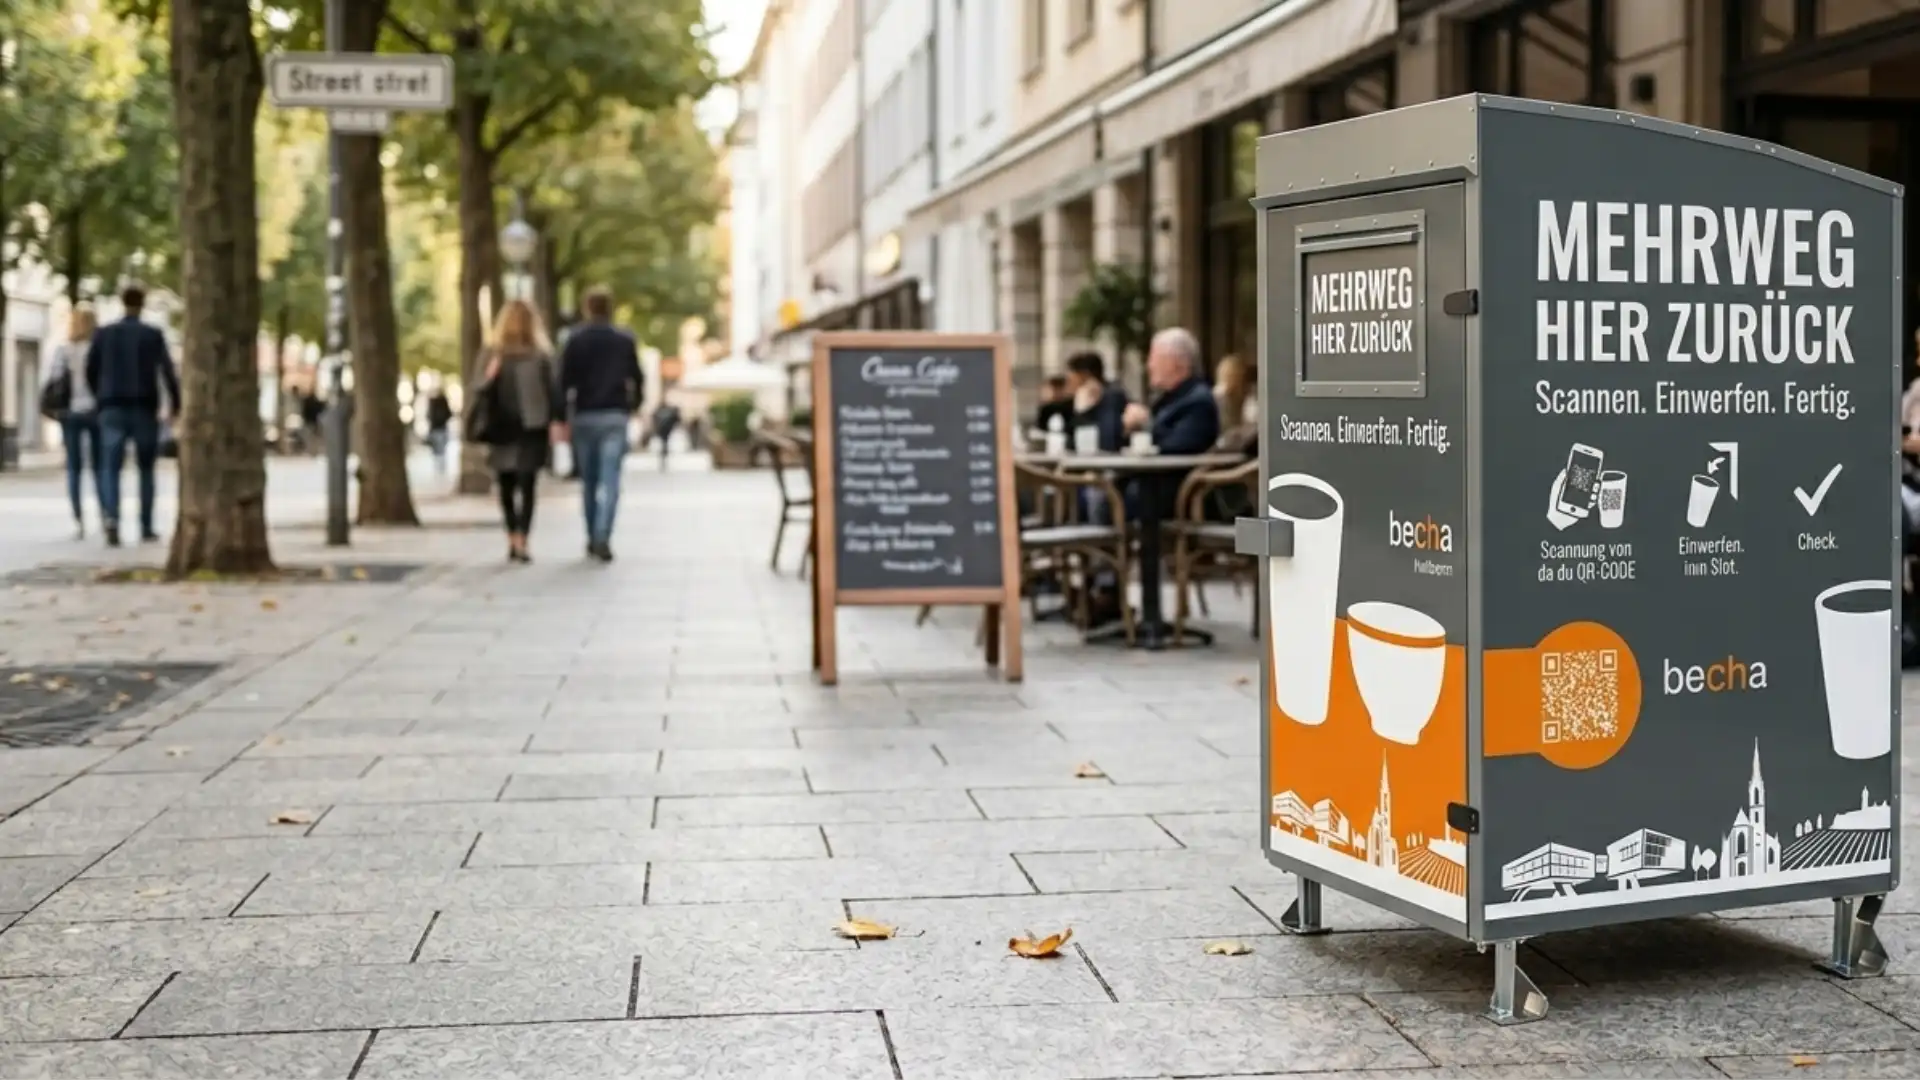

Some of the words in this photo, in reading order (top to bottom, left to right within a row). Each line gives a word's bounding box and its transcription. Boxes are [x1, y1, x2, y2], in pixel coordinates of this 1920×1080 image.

[289, 66, 363, 93] Street
[1537, 199, 1855, 288] MEHRWEG
[1312, 266, 1413, 314] MEHRWEG
[1312, 322, 1346, 355] HIER
[1350, 312, 1413, 353] ZURÜCK
[1536, 299, 1650, 362] HIER
[1667, 289, 1855, 364] ZURÜCK
[1535, 379, 1647, 414] Scannen.
[1656, 381, 1776, 414] Einwerfen.
[1784, 381, 1856, 420] Fertig.
[1280, 414, 1335, 443] Scannen.
[1389, 509, 1453, 552] becha
[1678, 535, 1745, 555] Einwerfen.
[1798, 531, 1839, 551] Check.
[1540, 540, 1606, 561] Scannung
[1609, 542, 1632, 557] von
[1711, 557, 1739, 576] Slot.
[1537, 564, 1554, 582] da
[1557, 563, 1573, 581] du
[1576, 560, 1636, 583] QR-CODE
[1663, 655, 1767, 694] becha
